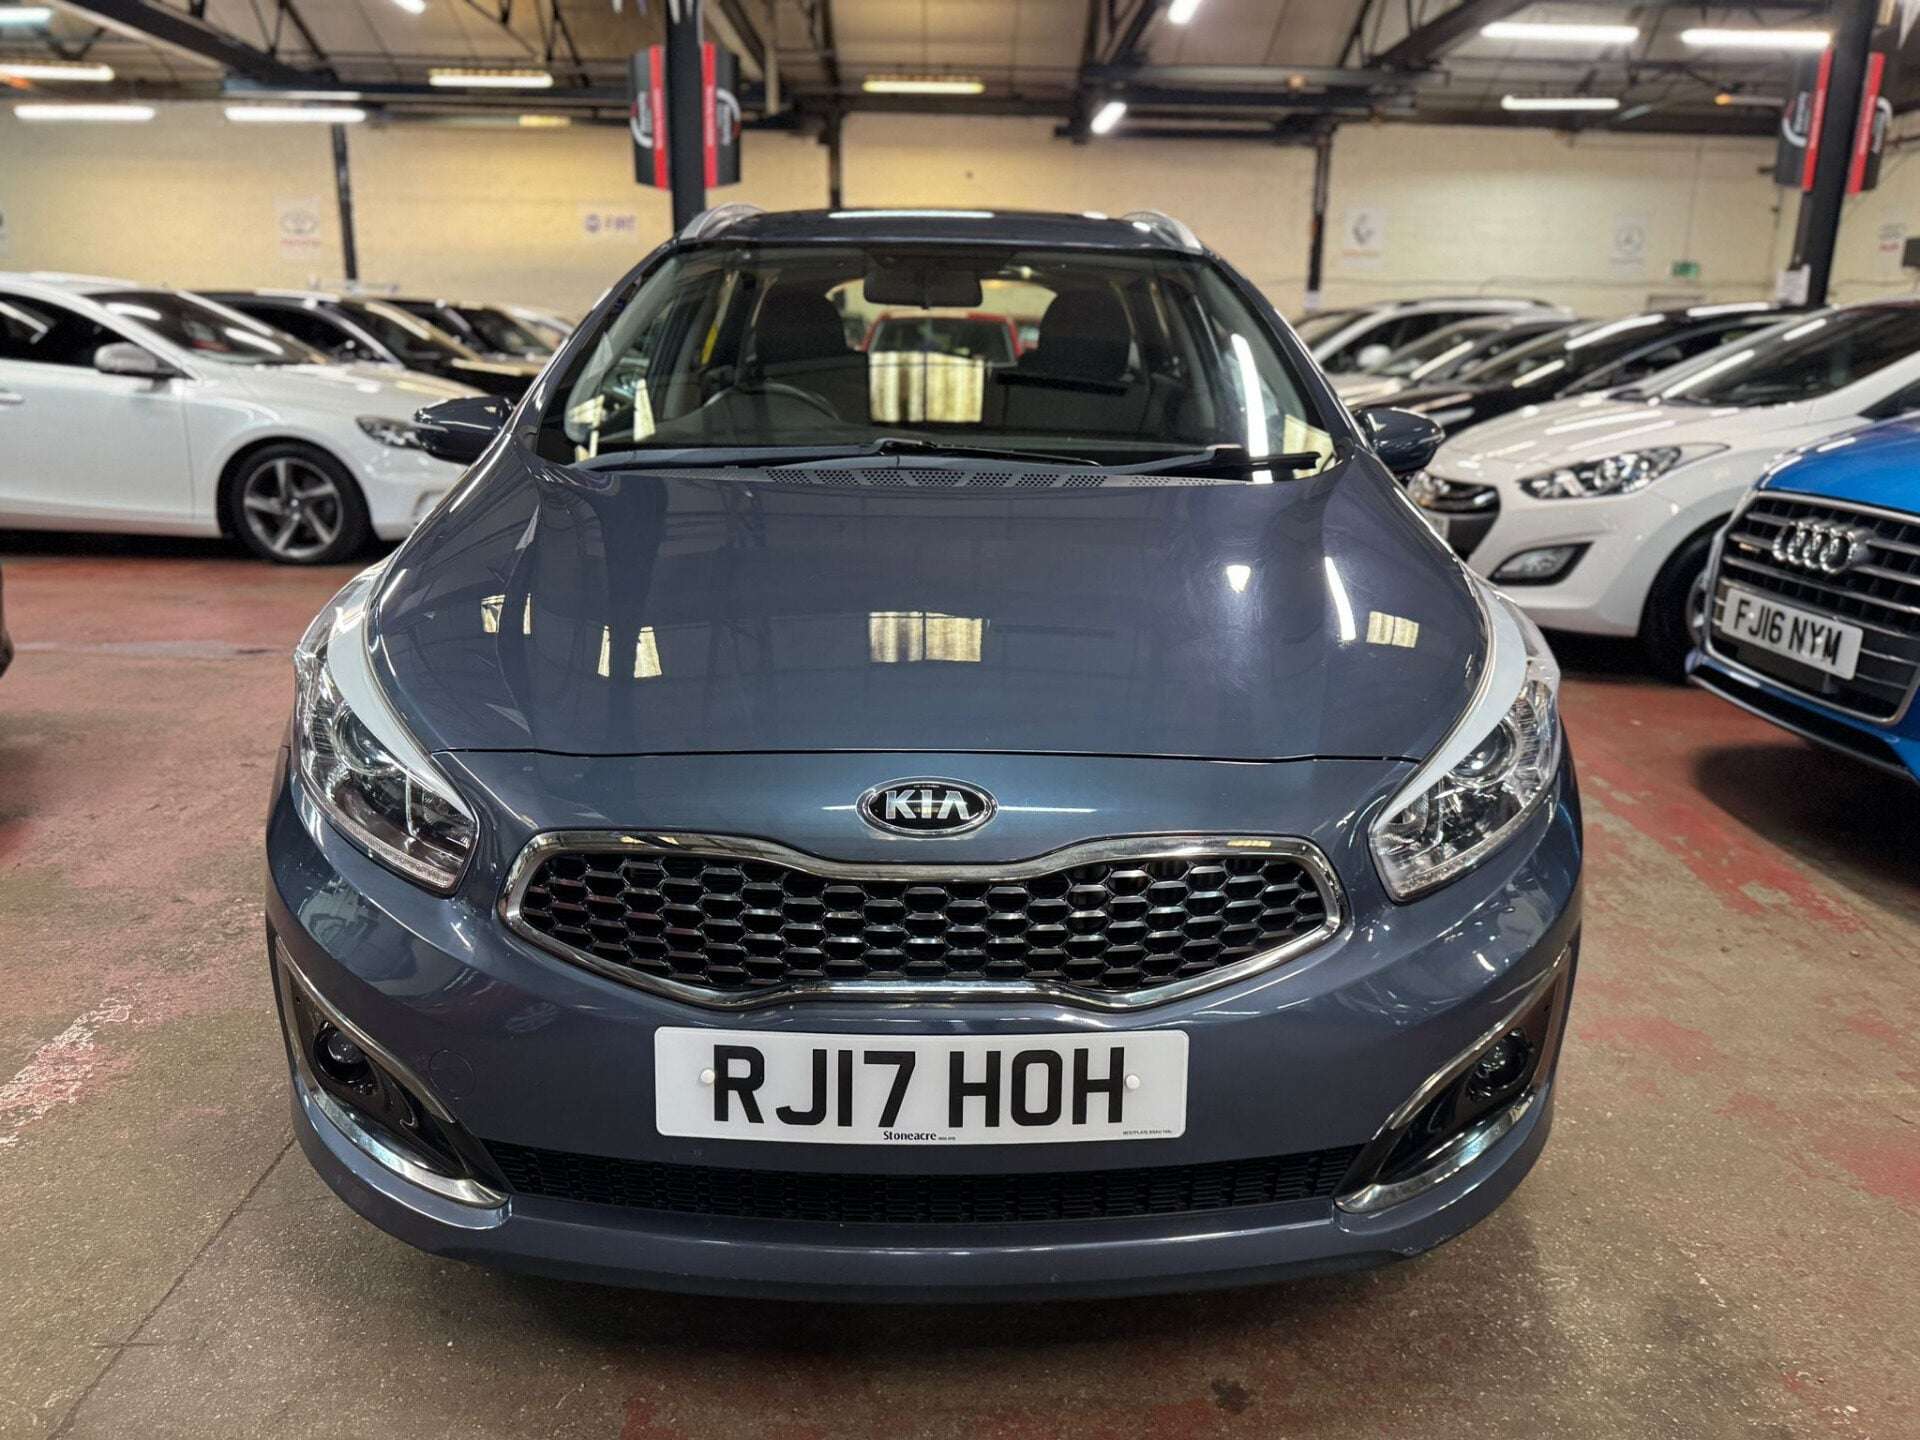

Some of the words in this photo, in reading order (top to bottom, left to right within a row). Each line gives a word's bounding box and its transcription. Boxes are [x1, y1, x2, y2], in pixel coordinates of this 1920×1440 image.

[1734, 598, 1785, 644] FJ16
[1788, 616, 1842, 666] NYM
[885, 789, 970, 820] KIA
[714, 1044, 916, 1128] RJ17
[949, 1046, 1125, 1128] HOH
[883, 1130, 937, 1141] Stoneacre
